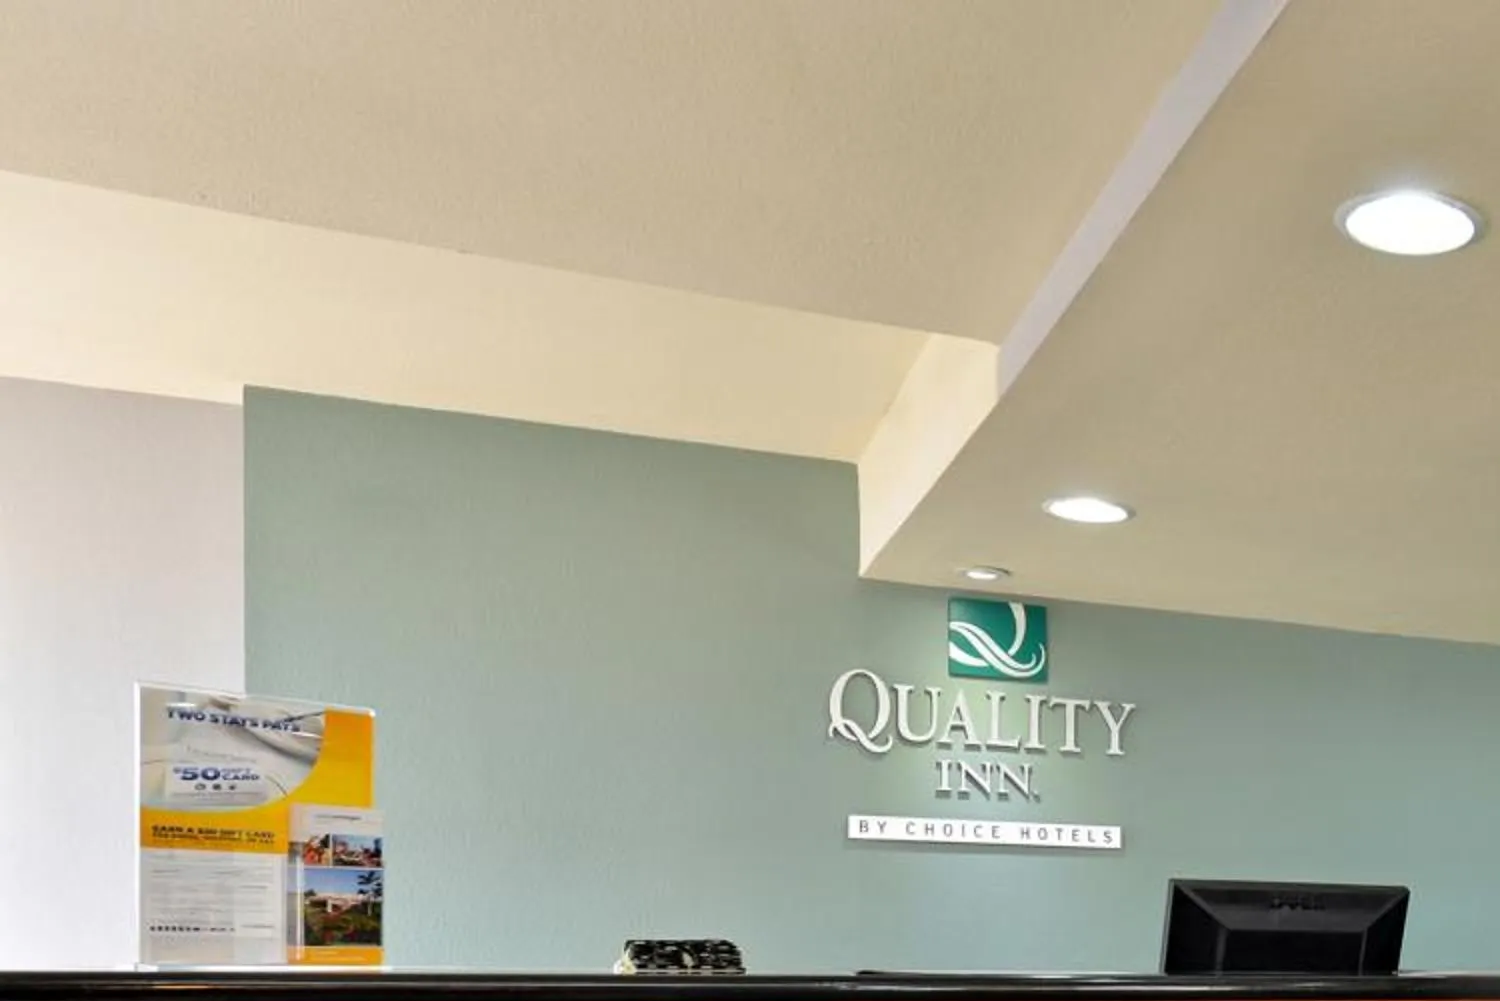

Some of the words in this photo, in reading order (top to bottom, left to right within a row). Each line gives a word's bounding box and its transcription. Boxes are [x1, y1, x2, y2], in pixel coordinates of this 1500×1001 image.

[828, 668, 1136, 757] QUALITY
[935, 759, 1031, 798] INN
[858, 819, 887, 834] BY
[904, 820, 1001, 839] CHOICE
[1019, 824, 1114, 844] HOTELS
